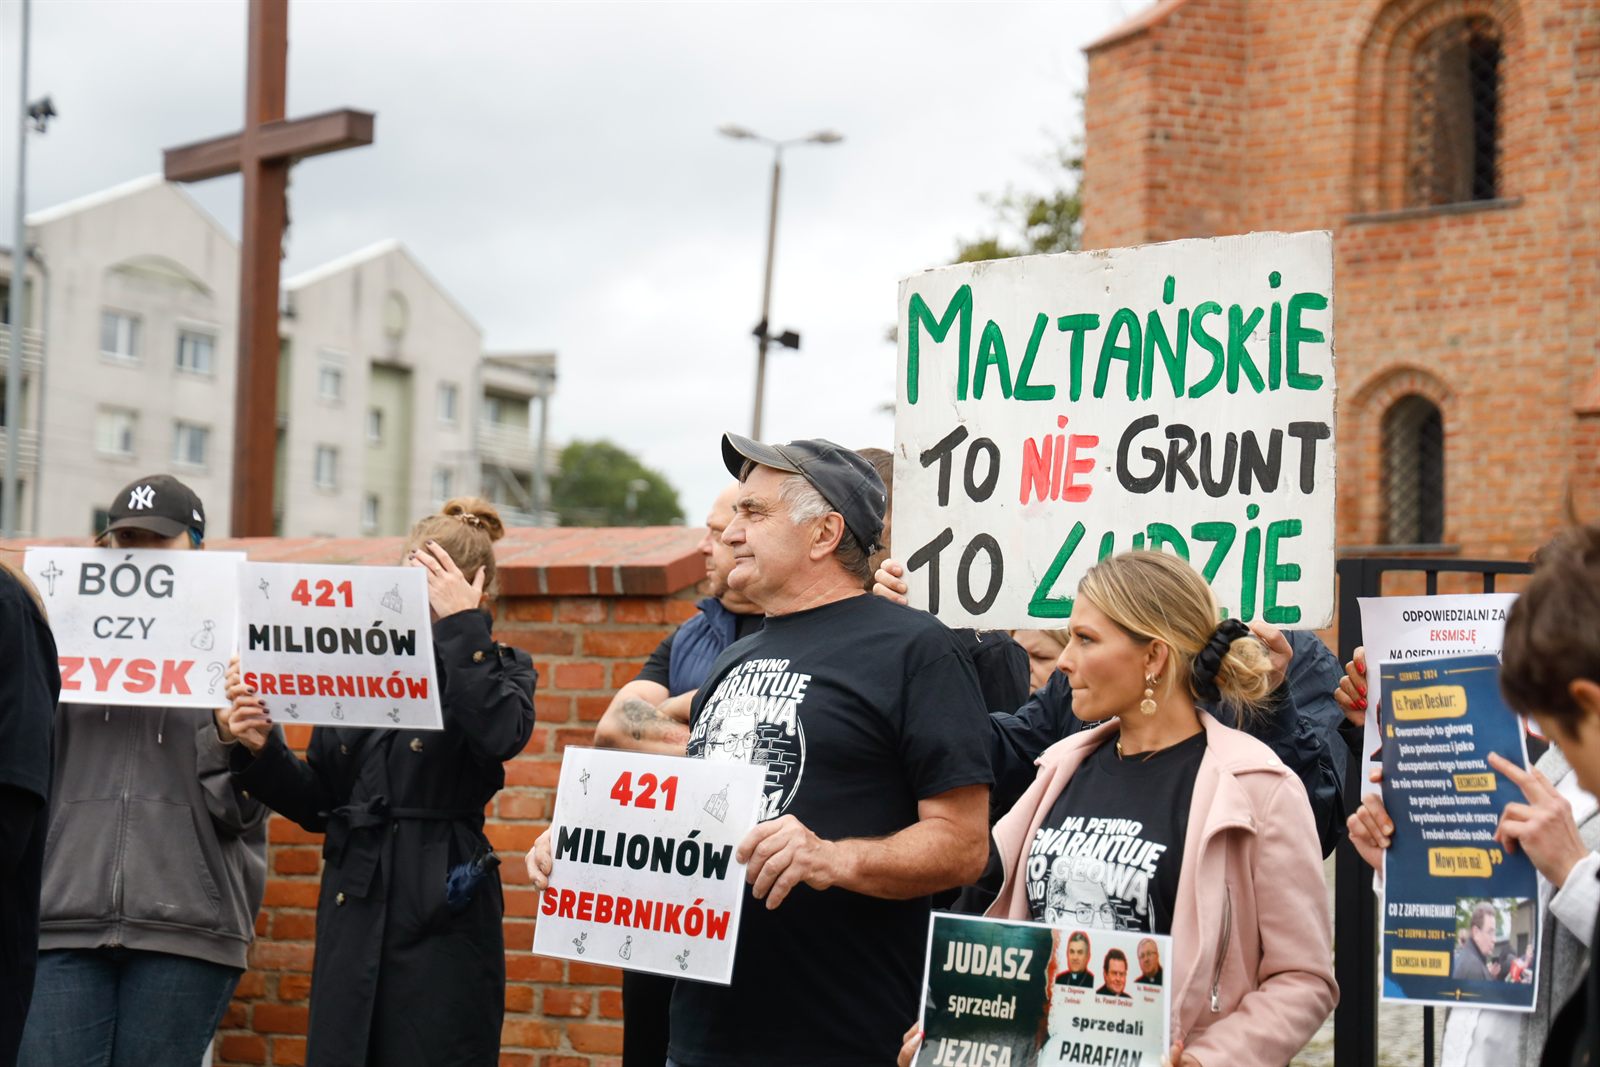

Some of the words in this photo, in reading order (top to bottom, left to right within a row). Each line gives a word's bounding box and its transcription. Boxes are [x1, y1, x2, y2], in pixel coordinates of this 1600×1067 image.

[920, 425, 1000, 506] TO
[1019, 414, 1099, 505] NIE
[1116, 414, 1331, 498] GRUNT
[128, 485, 156, 510] NY
[78, 554, 175, 598] BÓG
[907, 527, 1004, 615] TO
[291, 579, 354, 607] 421
[93, 616, 156, 639] CZY
[1402, 609, 1489, 622] ODPOWIEDZIALNI
[1492, 609, 1506, 621] ZA
[249, 620, 416, 656] MILIONÓW
[1430, 629, 1477, 644] EKSMISJĘ
[58, 656, 195, 695] ZYSK
[741, 659, 790, 674] PEWNO
[244, 671, 428, 699] SREBRNIKÓW
[714, 696, 797, 736] GŁOWĄ
[1399, 744, 1415, 757] jako
[1416, 743, 1450, 756] proboszcz
[1455, 741, 1475, 755] jako
[1397, 761, 1439, 773] duszpasterz
[610, 771, 678, 811] 421
[1401, 778, 1411, 788] nie
[1412, 779, 1424, 788] ma
[1424, 779, 1445, 791] mowy
[1455, 794, 1491, 805] komornik
[1060, 816, 1085, 832] NA
[1085, 817, 1143, 837] PEWNO
[1456, 812, 1474, 823] bruk
[1474, 813, 1498, 826] rzeczy
[555, 826, 733, 880] MILIONÓW
[1051, 856, 1150, 916] GŁOWĄ
[541, 887, 730, 941] SREBRNIKÓW
[1388, 903, 1398, 917] CO
[1399, 903, 1403, 917] Z
[943, 941, 1033, 981] JUDASZ
[948, 994, 1016, 1020] sprzedał
[1072, 1016, 1143, 1036] sprzedali
[933, 1037, 1012, 1067] JEZUSA
[1059, 1041, 1143, 1067] PARAFIAN
